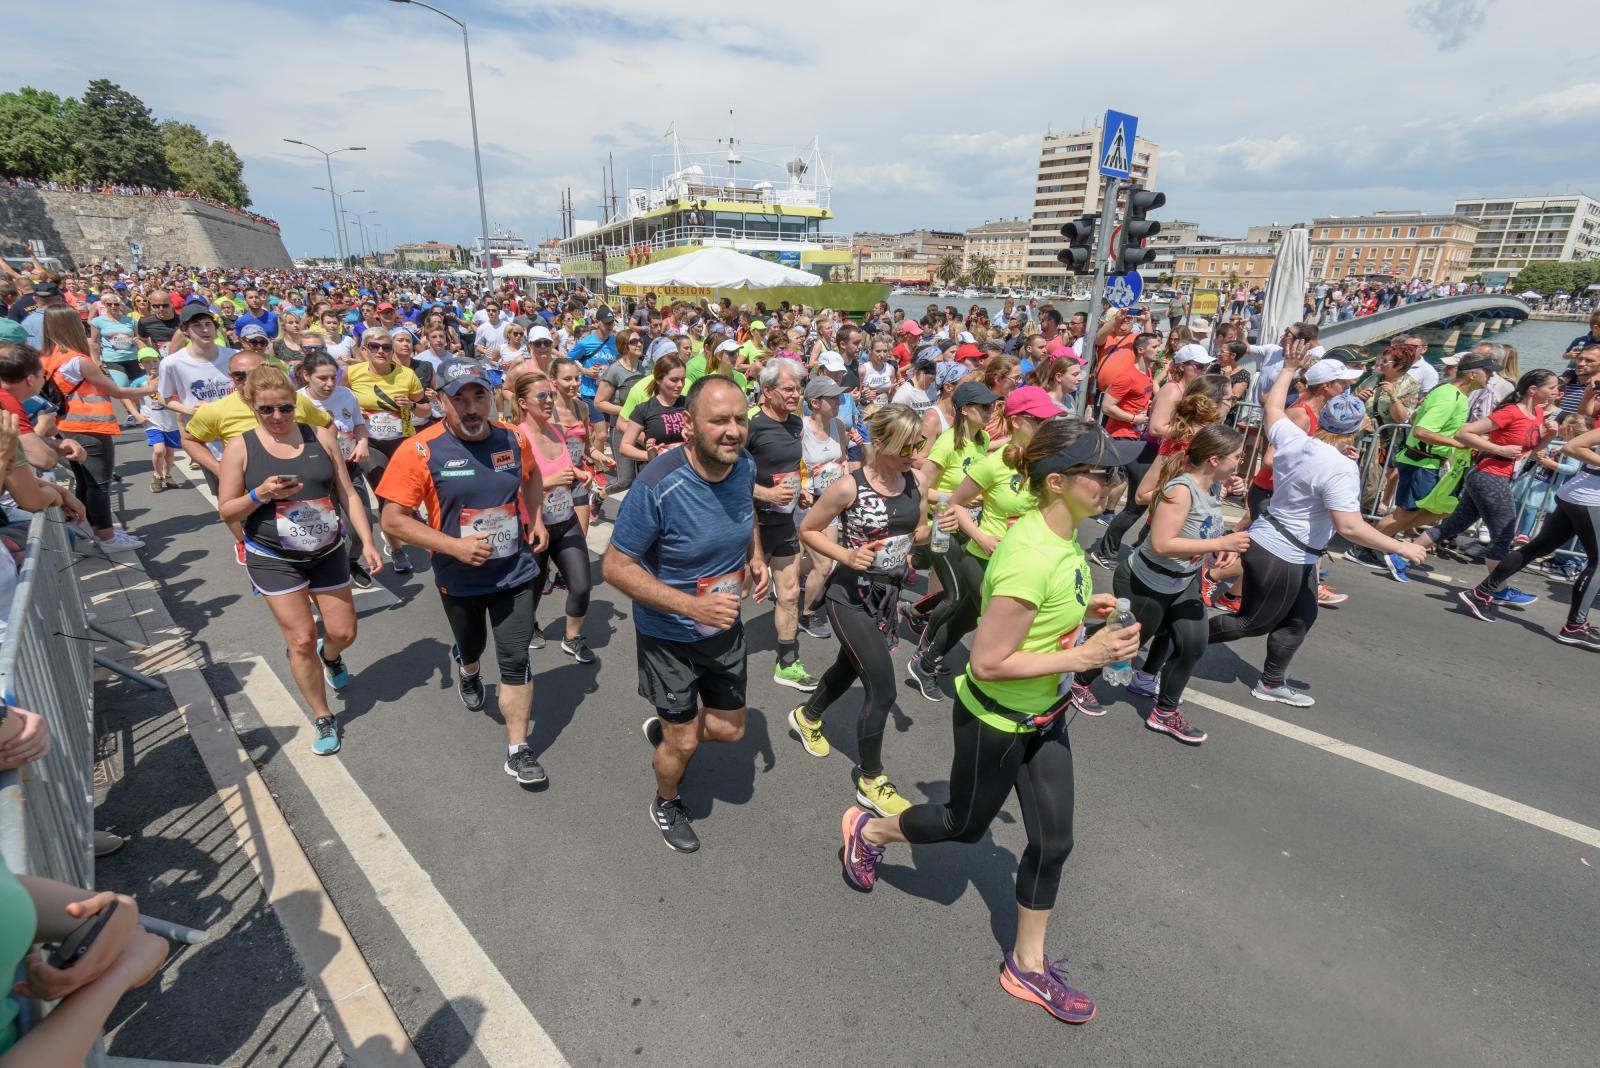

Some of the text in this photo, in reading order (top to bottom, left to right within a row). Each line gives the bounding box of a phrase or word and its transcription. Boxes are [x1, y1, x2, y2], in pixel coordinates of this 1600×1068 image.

[643, 285, 711, 296] EXCURSIONS
[200, 388, 226, 399] WORLD
[371, 424, 397, 433] 38785
[290, 522, 330, 538] 33735
